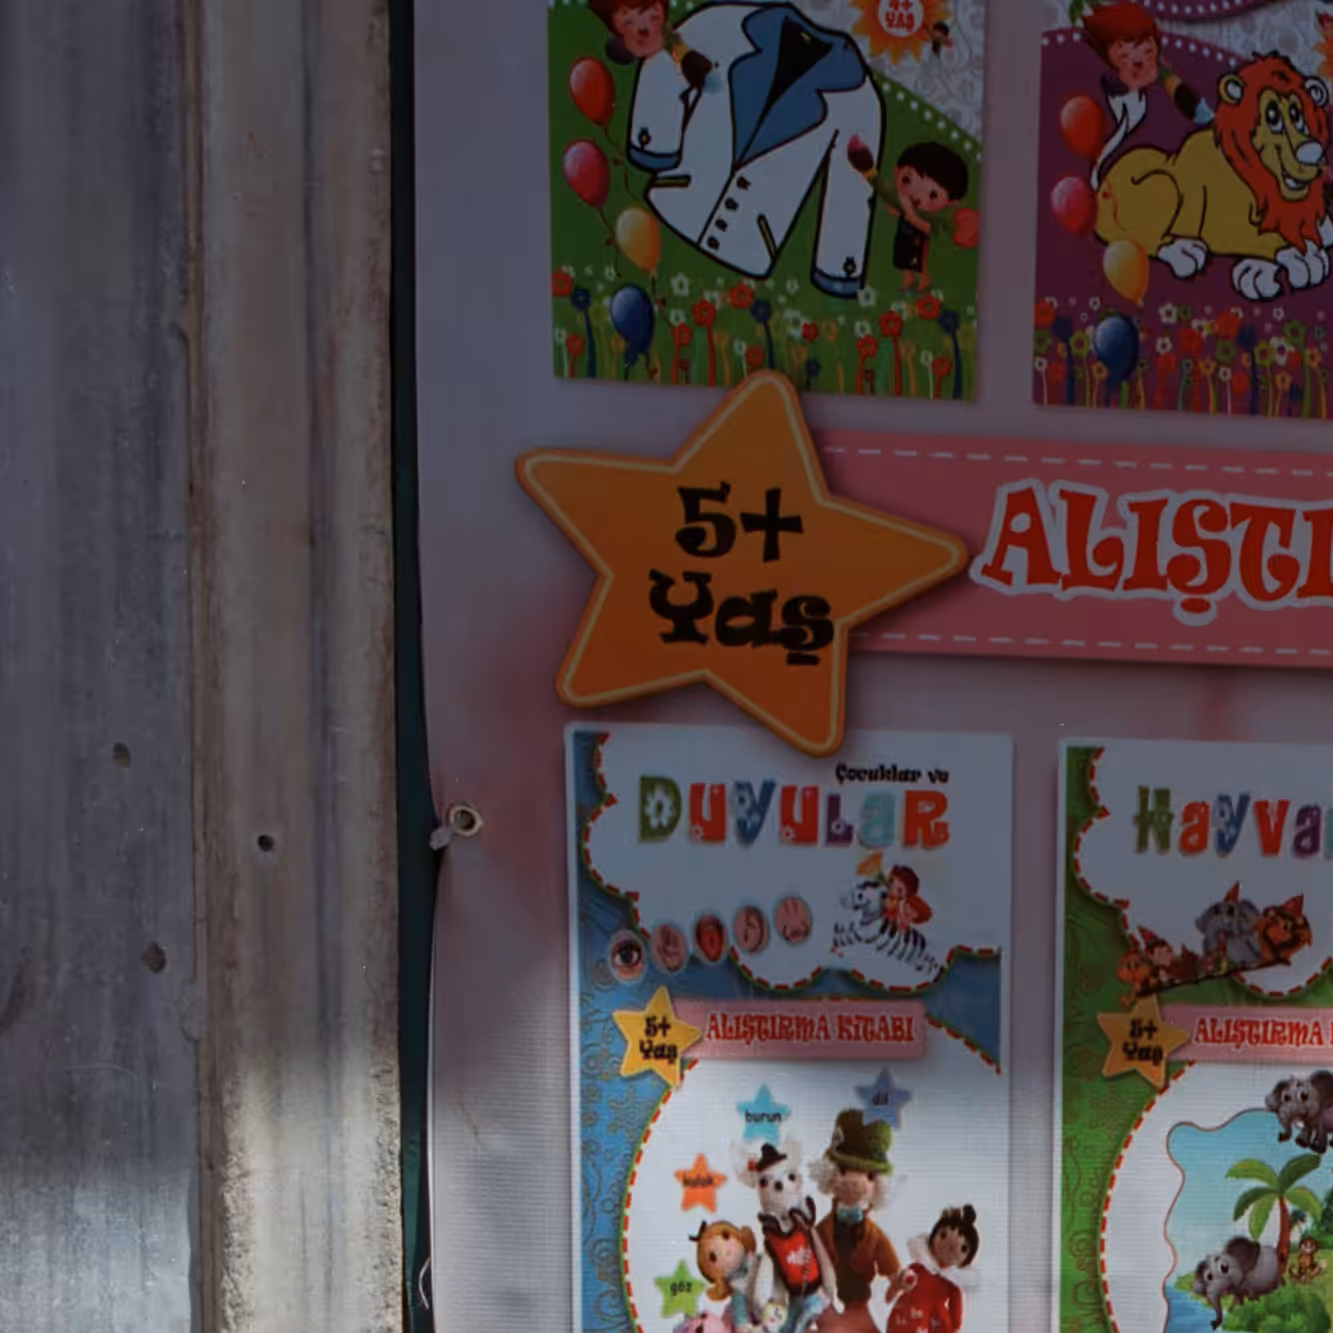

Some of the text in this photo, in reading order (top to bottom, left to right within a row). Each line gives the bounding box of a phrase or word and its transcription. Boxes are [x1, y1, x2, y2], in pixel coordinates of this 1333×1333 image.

[667, 481, 804, 563] 5+
[648, 568, 835, 667] Yaş
[644, 1016, 671, 1037] 5+
[1129, 1020, 1158, 1039] 5+
[746, 1108, 783, 1129] burun
[671, 1279, 694, 1298] göz
